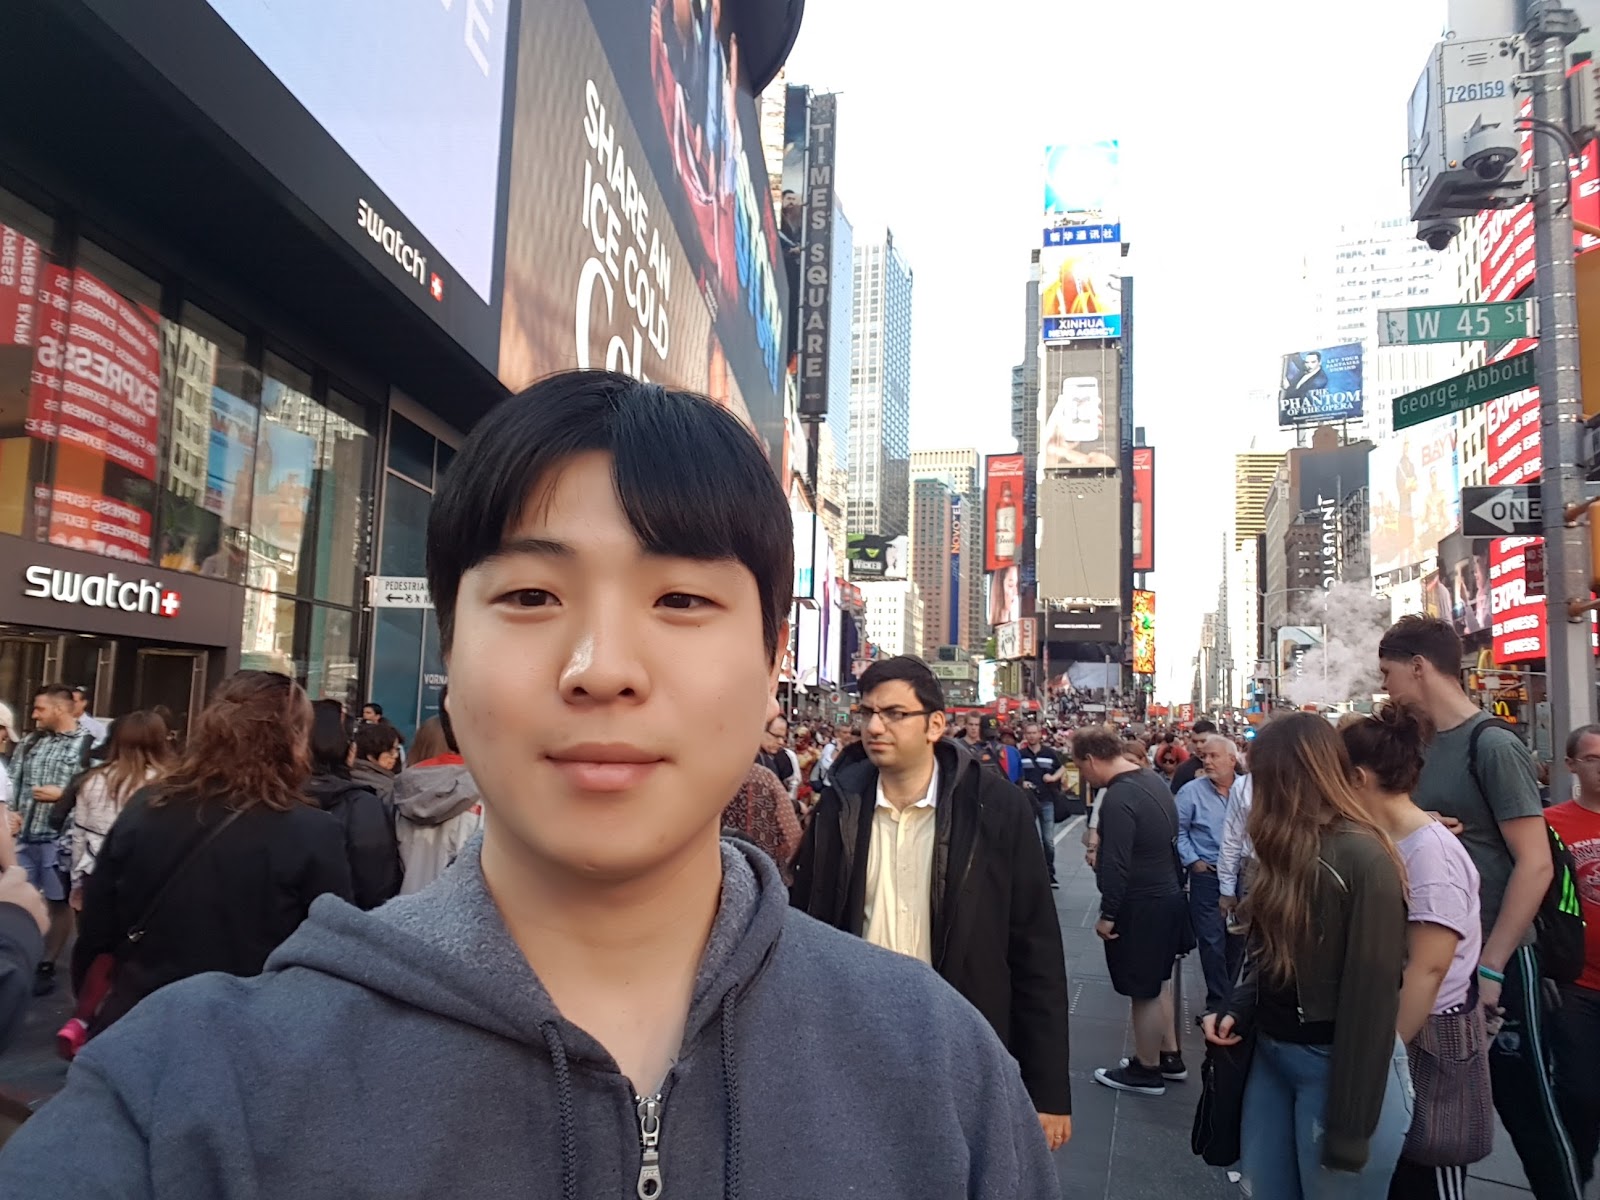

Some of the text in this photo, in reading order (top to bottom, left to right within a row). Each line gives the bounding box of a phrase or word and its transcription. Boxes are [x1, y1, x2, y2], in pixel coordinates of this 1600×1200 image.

[584, 79, 671, 301] SHARE AN
[358, 198, 426, 285] swatch
[582, 159, 669, 360] ICE COLD
[805, 123, 831, 378] TIMES SQUARE
[1058, 318, 1105, 330] XINHUA
[1415, 305, 1524, 339] W 45 St
[1280, 389, 1361, 412] PHANTOM
[1309, 388, 1329, 396] THE
[1399, 355, 1529, 415] George Abbott
[1450, 397, 1470, 410] Way
[1287, 408, 1300, 416] OF
[1301, 406, 1320, 414] THE
[1321, 402, 1354, 411] OPERA
[951, 500, 961, 555] NOVOTEL
[1491, 501, 1542, 520] ONE
[1320, 498, 1337, 597] INJUSTIC
[25, 565, 161, 615] swatch
[1491, 578, 1546, 615] EXPR
